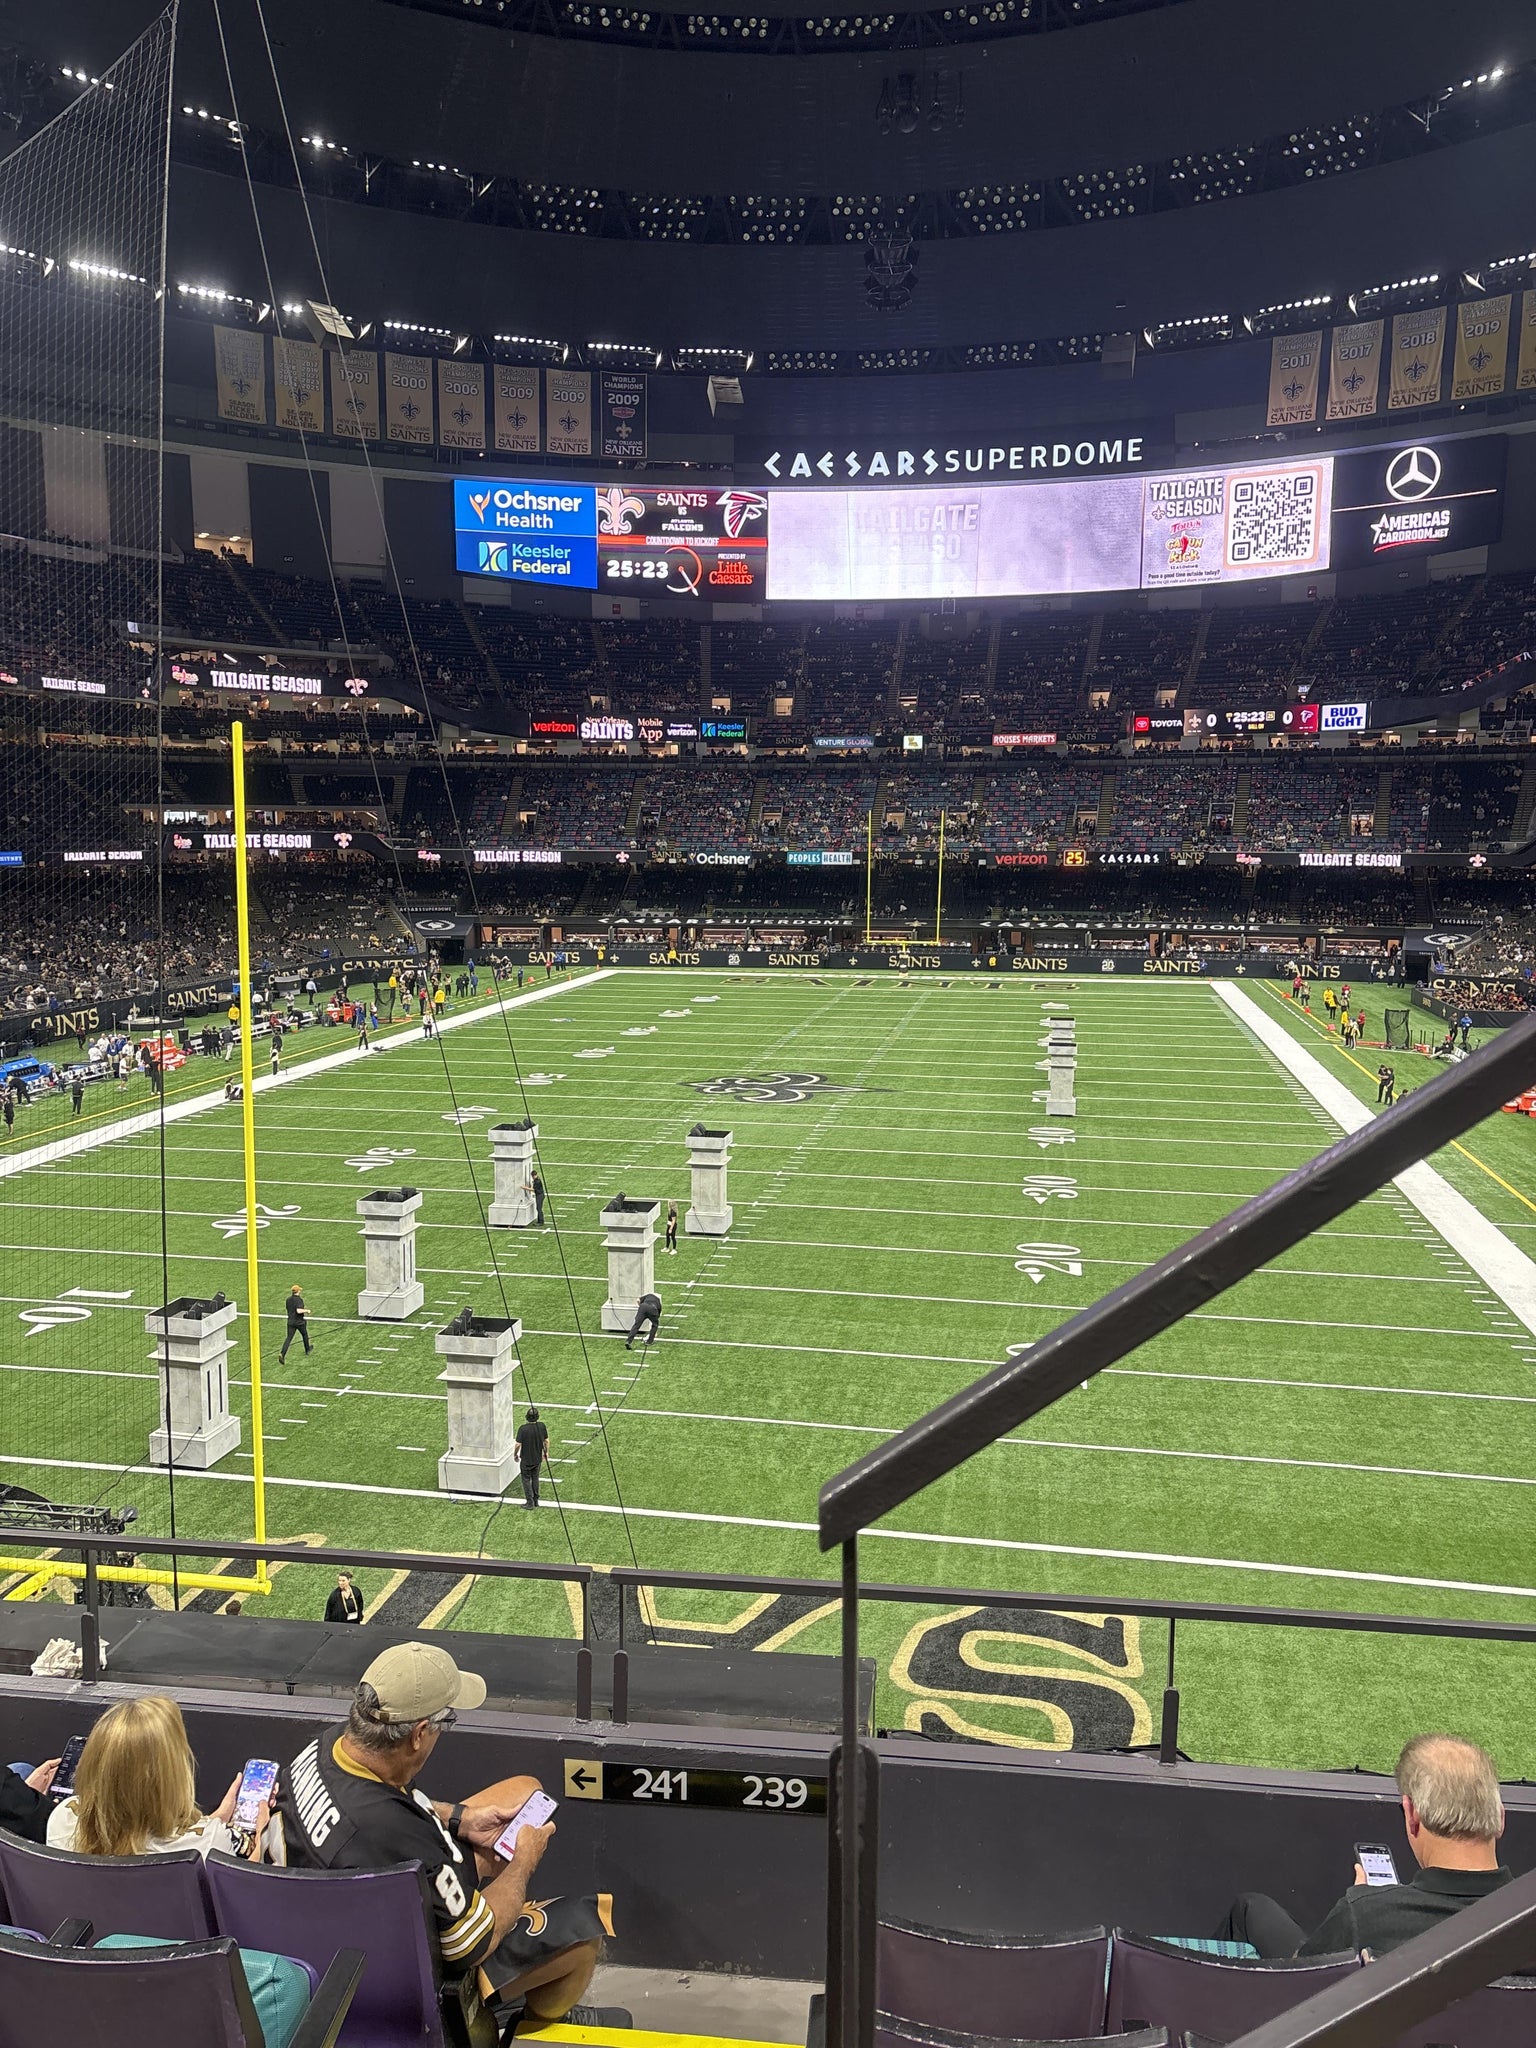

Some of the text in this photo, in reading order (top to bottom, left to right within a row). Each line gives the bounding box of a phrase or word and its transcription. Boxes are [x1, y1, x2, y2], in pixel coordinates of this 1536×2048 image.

[1465, 321, 1500, 338] 2019
[1400, 332, 1436, 349] 2018
[1341, 344, 1373, 360] 2017
[1280, 353, 1311, 369] 2011
[340, 369, 370, 384] 1991
[392, 374, 428, 391] 2000
[611, 375, 637, 384] WORLD
[445, 381, 479, 396] 2006
[603, 381, 644, 390] CHAMPIONS
[1455, 381, 1501, 398] SAINTS
[501, 386, 534, 399] 2009
[553, 390, 585, 403] 2009
[607, 393, 640, 405] 2009
[1391, 390, 1437, 407] SAINTS
[229, 399, 256, 408] SEASON
[230, 405, 255, 413] TICKET
[1330, 402, 1373, 417] SAINTS
[224, 410, 260, 421] HOLDERS
[1270, 410, 1312, 424] SAINTS
[282, 418, 319, 429] HOLDERS
[336, 423, 377, 438] SAINTS
[390, 428, 431, 442] SAINTS
[443, 434, 483, 448] SAINTS
[498, 438, 537, 450] SAINTS
[550, 441, 588, 453] SAINTS
[605, 444, 643, 456] SAINTS
[764, 438, 1144, 478] CAESARS SUPERDOME
[1150, 478, 1223, 500] TAILGATE
[493, 489, 582, 512] Ochsner
[657, 493, 708, 507] SAINTS
[677, 507, 687, 515] VS
[1166, 497, 1222, 517] SEASON
[496, 511, 554, 529] Health
[1376, 510, 1451, 532] AMERICAS
[661, 523, 704, 531] FALCONS
[645, 536, 720, 546] COUNTDOWN TO KICKOFF
[1378, 528, 1450, 544] CARDROOM.NET
[512, 543, 571, 559] Keesler
[512, 559, 571, 575] Federal
[607, 560, 669, 578] 25:23
[717, 561, 748, 574] Little
[709, 571, 753, 585] Caesars
[41, 677, 106, 694] TAILGATE SEASON
[210, 670, 270, 691] TAILGATE
[272, 676, 322, 695] SEASON
[1232, 711, 1266, 723] 25:23
[1282, 711, 1294, 725] 0
[1330, 707, 1358, 717] BUD
[602, 716, 629, 724] Orleans
[637, 718, 664, 727] Mobile
[717, 722, 745, 731] Keesler
[1151, 719, 1183, 729] TOYOTA
[1206, 713, 1217, 727] 0
[1324, 717, 1363, 728] LIGHT
[200, 727, 231, 736] SAINTS
[271, 729, 302, 738] SAINTS
[532, 721, 576, 733] verizon
[581, 722, 634, 739] SAINTS
[638, 727, 663, 740] App
[667, 728, 697, 736] verizon
[339, 731, 369, 740] SAINTS
[717, 730, 745, 738] Federal
[931, 735, 962, 744] SAINTS
[993, 733, 1056, 744] ROUSES MARKETS
[1066, 733, 1097, 742] SAINTS
[775, 737, 804, 745] SAINTS
[814, 738, 874, 746] VENTURE GLOBAL
[203, 833, 261, 848] TAILGTE
[263, 833, 312, 848] SEASON
[473, 850, 562, 863] TAILGATE SEASON
[651, 851, 682, 859] SAINTS
[696, 853, 750, 865] Ochsner
[788, 853, 851, 863] PEOPLES HEALTH
[995, 852, 1048, 865] verizon
[1065, 852, 1083, 865] 25
[1099, 853, 1160, 864] CAESARS
[1170, 851, 1205, 860] SAINTS
[1299, 853, 1402, 867] TAILGATE SEASON
[720, 918, 854, 926] SUPERDOME
[979, 921, 1261, 932] CAESARS SUPERDOME
[768, 953, 820, 966] SAINTS
[1012, 957, 1068, 971] SAINTS
[1143, 960, 1200, 973] SAINTS
[167, 985, 219, 1008] SAINTS
[344, 1147, 418, 1168] 30
[1022, 1174, 1079, 1199] 30
[211, 1203, 302, 1231] 20
[1014, 1242, 1083, 1277] 20
[18, 1286, 135, 1324] 10
[289, 1738, 342, 1848] MANNING
[632, 1768, 808, 1809] 241 239
[434, 1864, 466, 1918] 8
